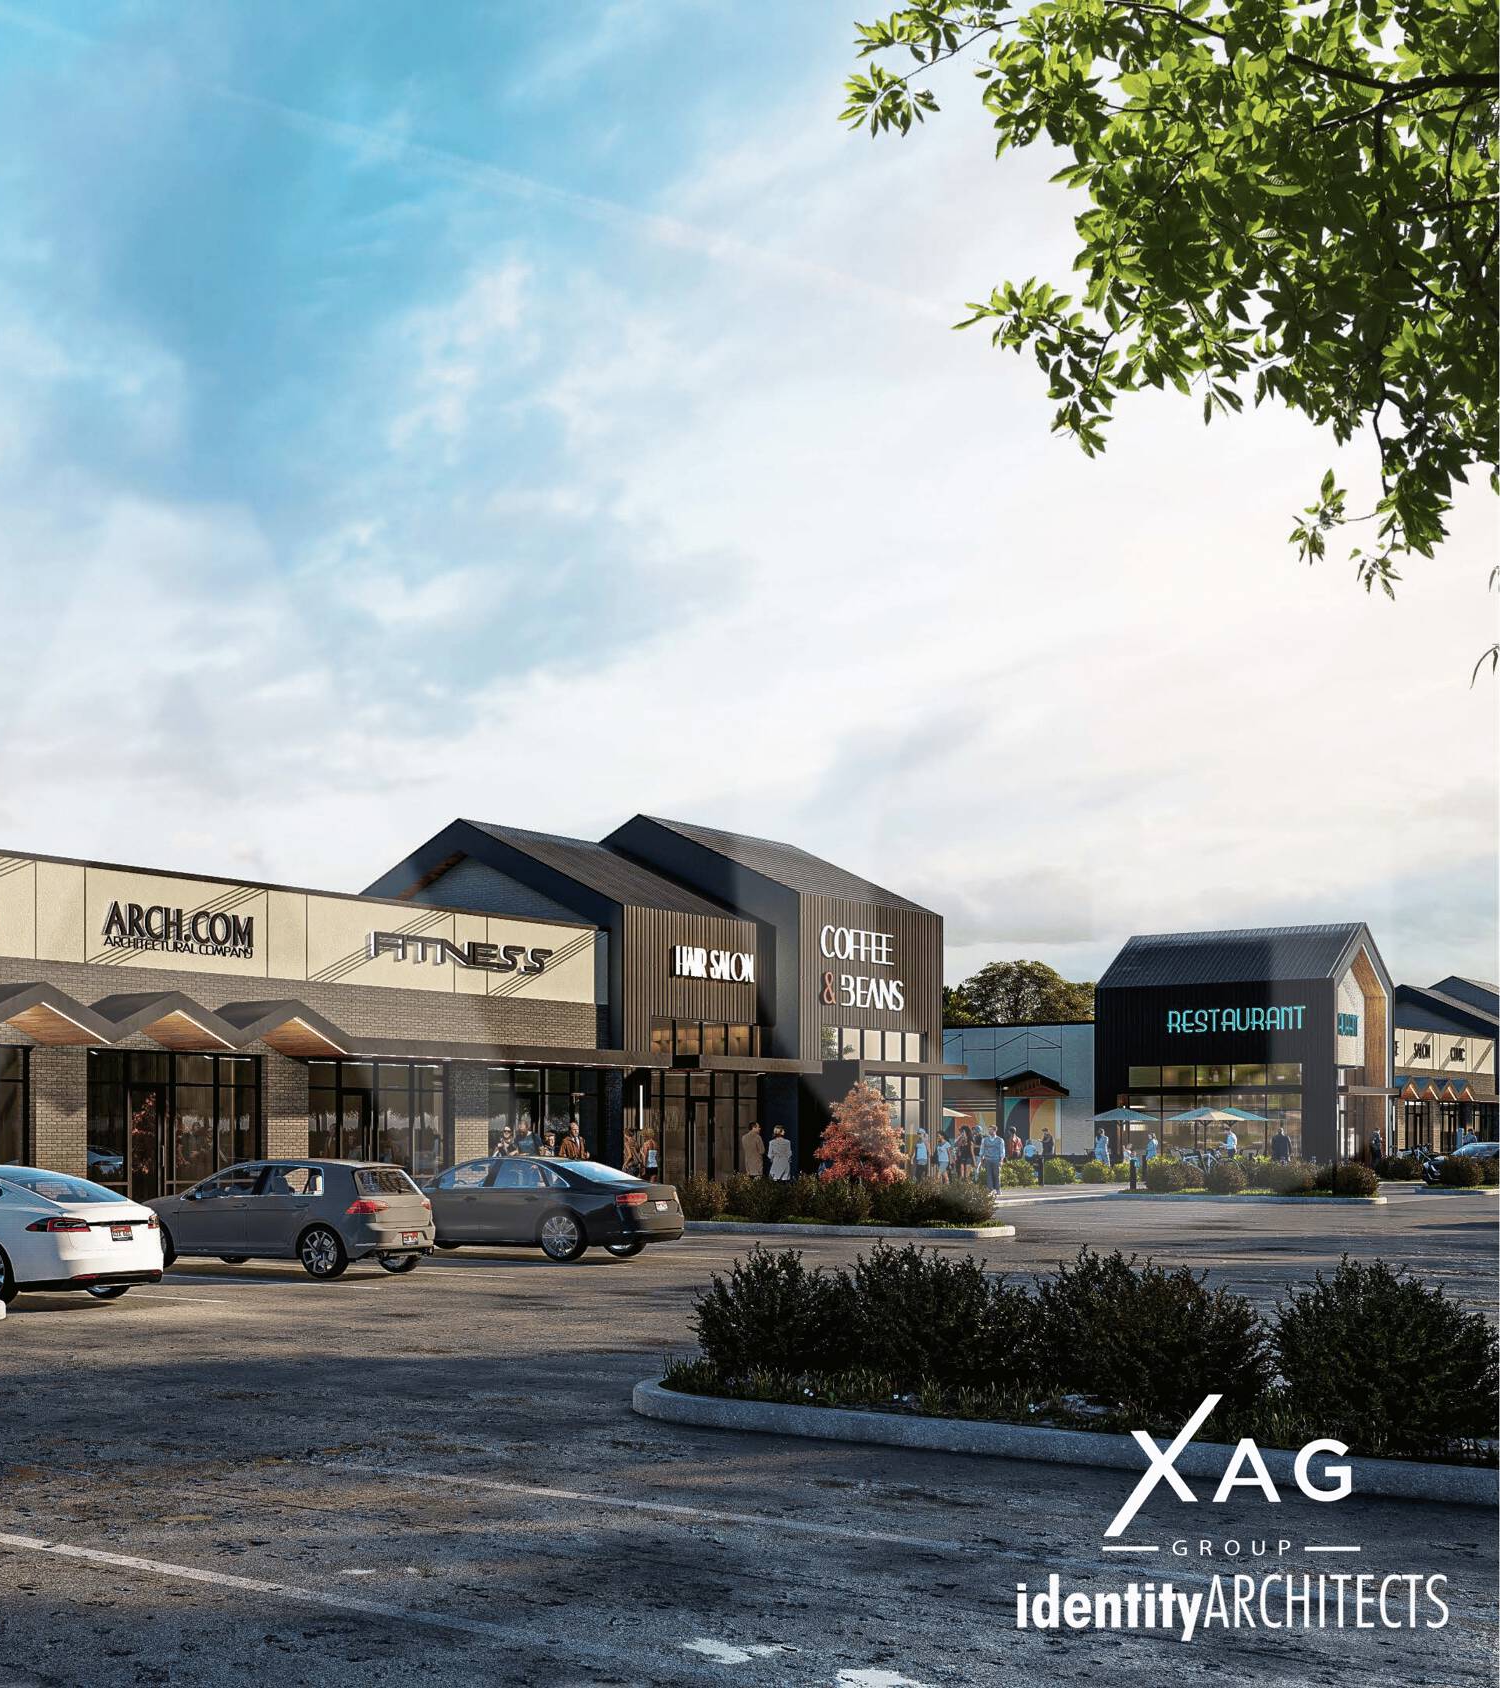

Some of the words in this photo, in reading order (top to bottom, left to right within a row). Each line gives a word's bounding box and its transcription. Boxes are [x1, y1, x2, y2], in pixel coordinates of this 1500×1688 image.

[102, 900, 255, 948] ARCH.COM
[103, 934, 198, 955] ARCHITECTURAL
[365, 930, 555, 975] FITNESS
[674, 944, 708, 979] HAIR
[710, 949, 755, 983] SALON
[820, 924, 895, 966] COFFEE
[823, 971, 836, 1005] &
[841, 974, 905, 1012] BEANS
[1167, 1005, 1307, 1034] RESTAURANT
